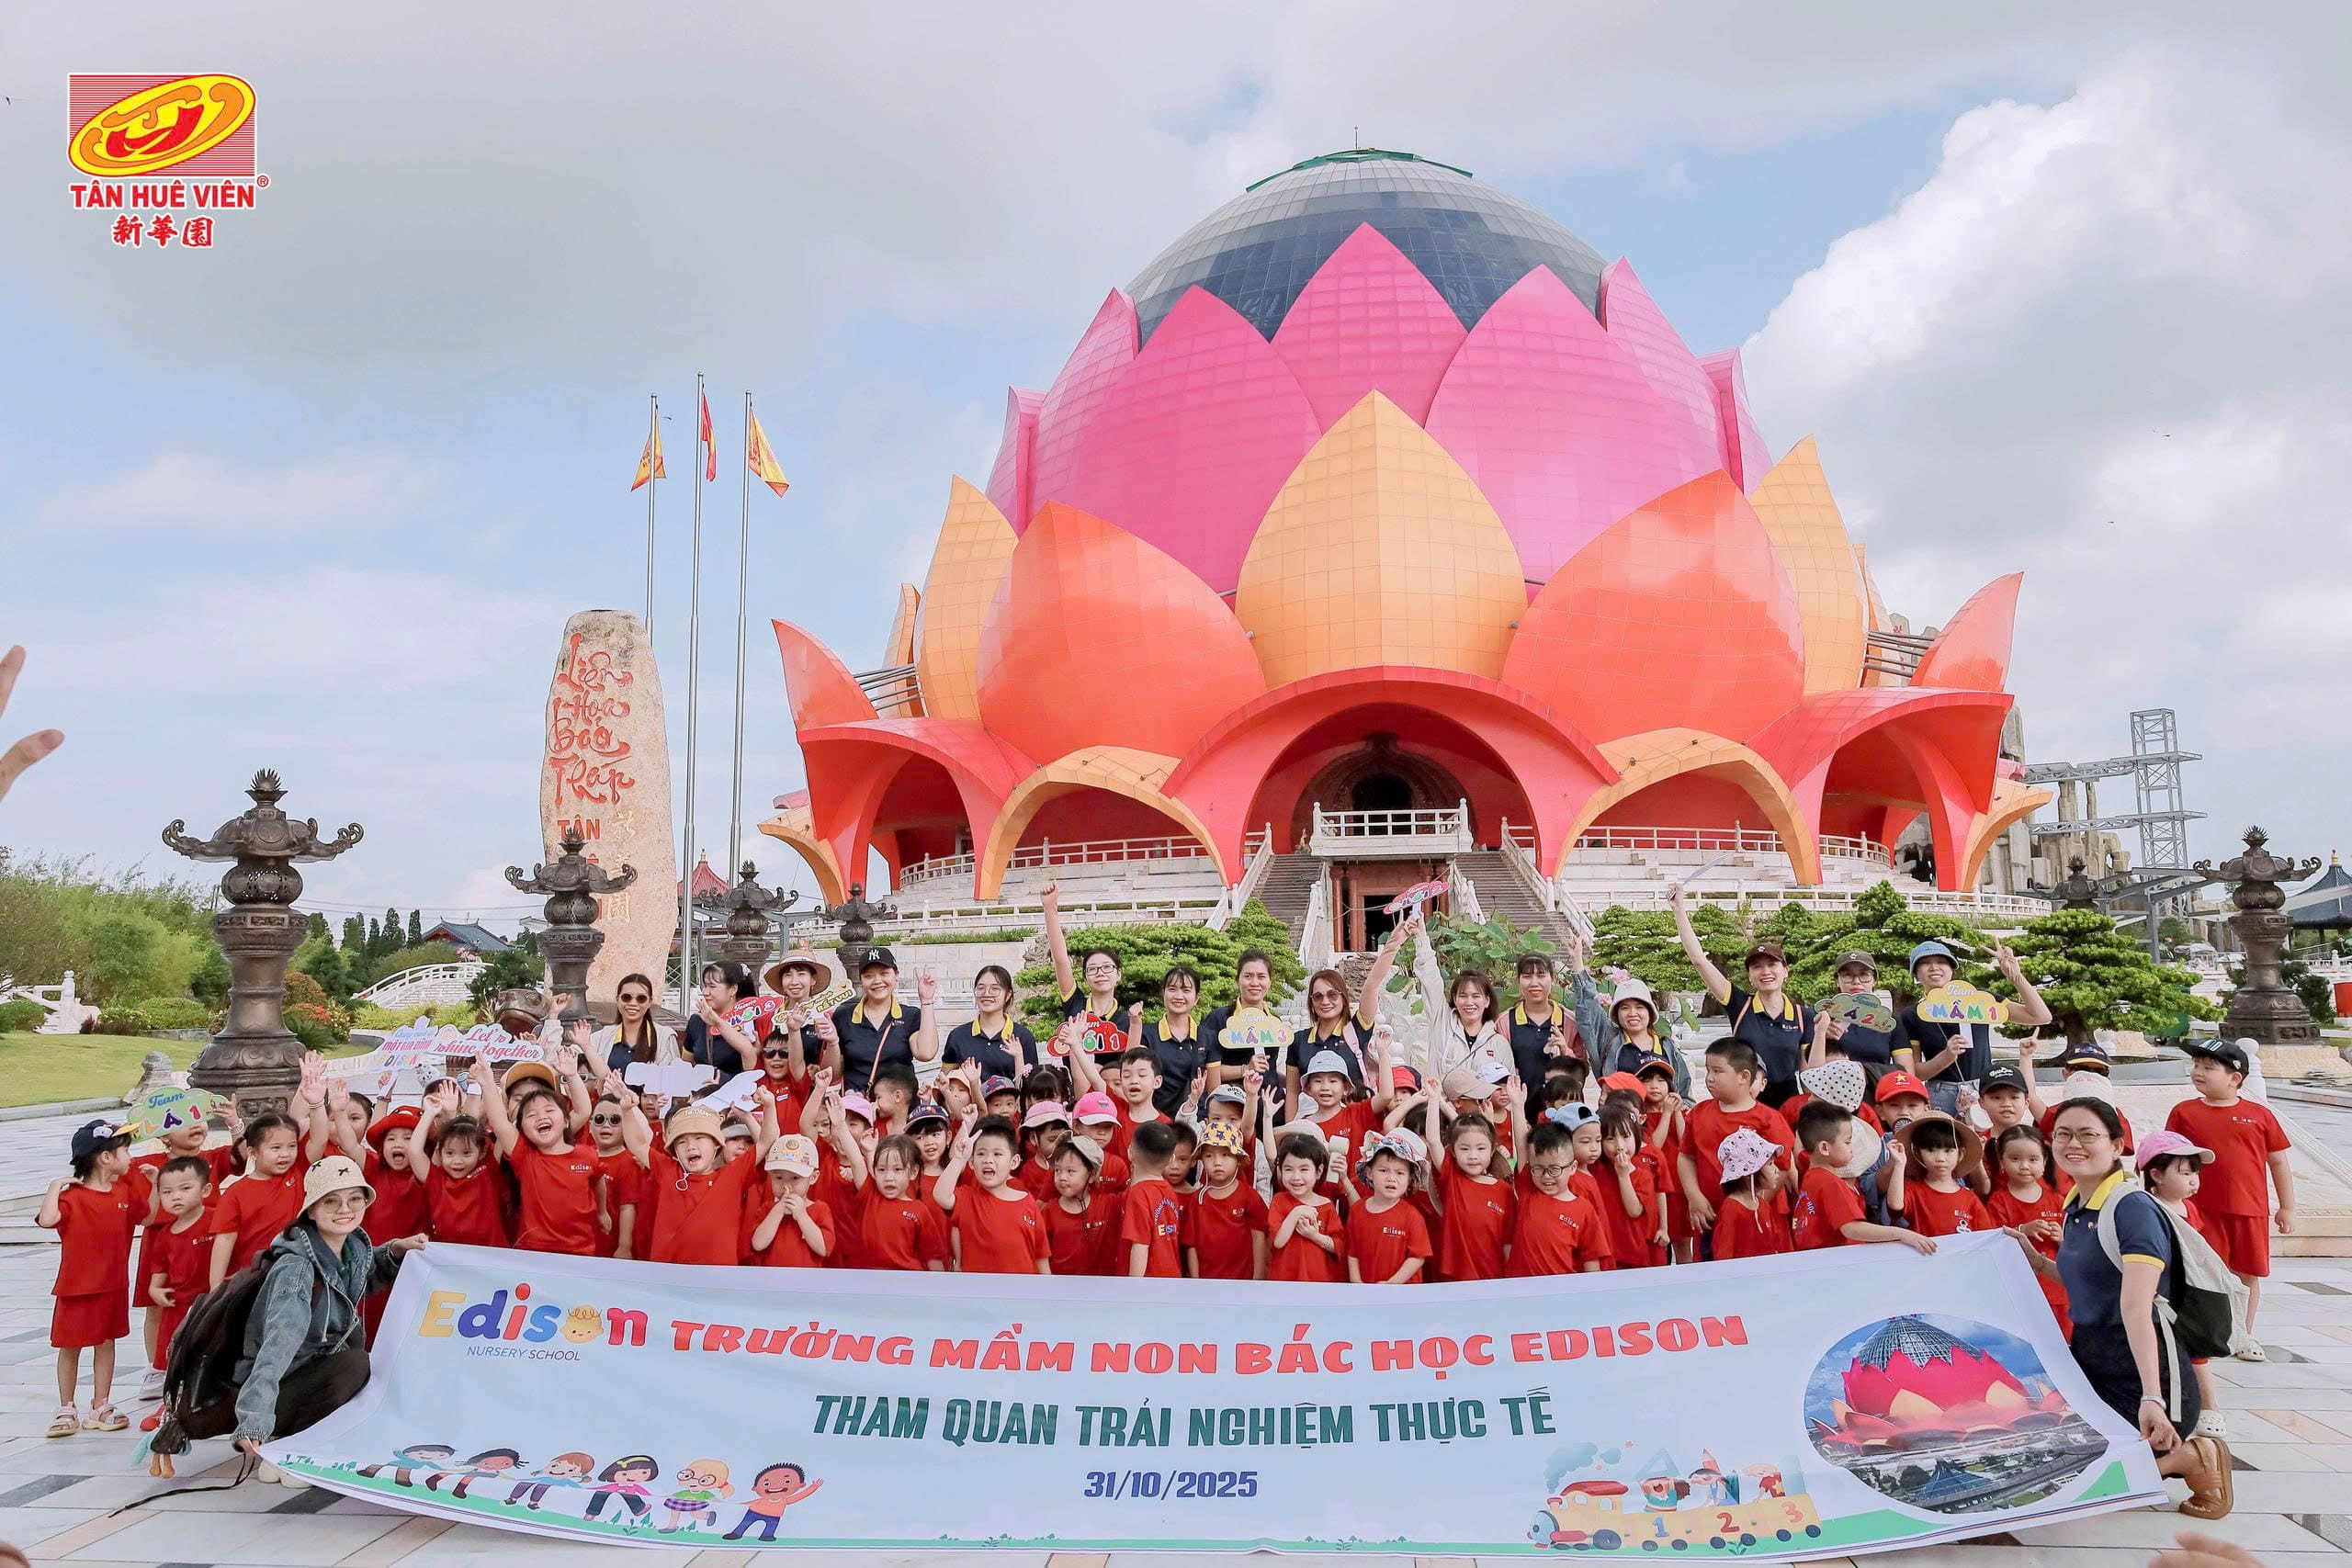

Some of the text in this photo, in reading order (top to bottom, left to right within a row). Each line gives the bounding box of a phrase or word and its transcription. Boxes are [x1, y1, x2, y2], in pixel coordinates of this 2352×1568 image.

[557, 814, 601, 840] TÂN
[1860, 1013, 1875, 1024] 2
[1988, 1006, 1997, 1021] 1
[481, 1042, 540, 1059] together
[149, 1091, 185, 1109] Team
[189, 1104, 201, 1121] 1
[417, 1282, 649, 1347] Edison
[467, 1345, 581, 1361] NURSERY SCHOOL
[670, 1314, 1749, 1381] TRƯỜNG MẦM NON BÁC HỌC EDISON
[813, 1385, 1556, 1450] THAM QUAN TRẢI NGHIỆM THỰC TẾ
[1082, 1470, 1259, 1499] 31/10/2025
[1652, 1500, 1804, 1539] 1 2 3
